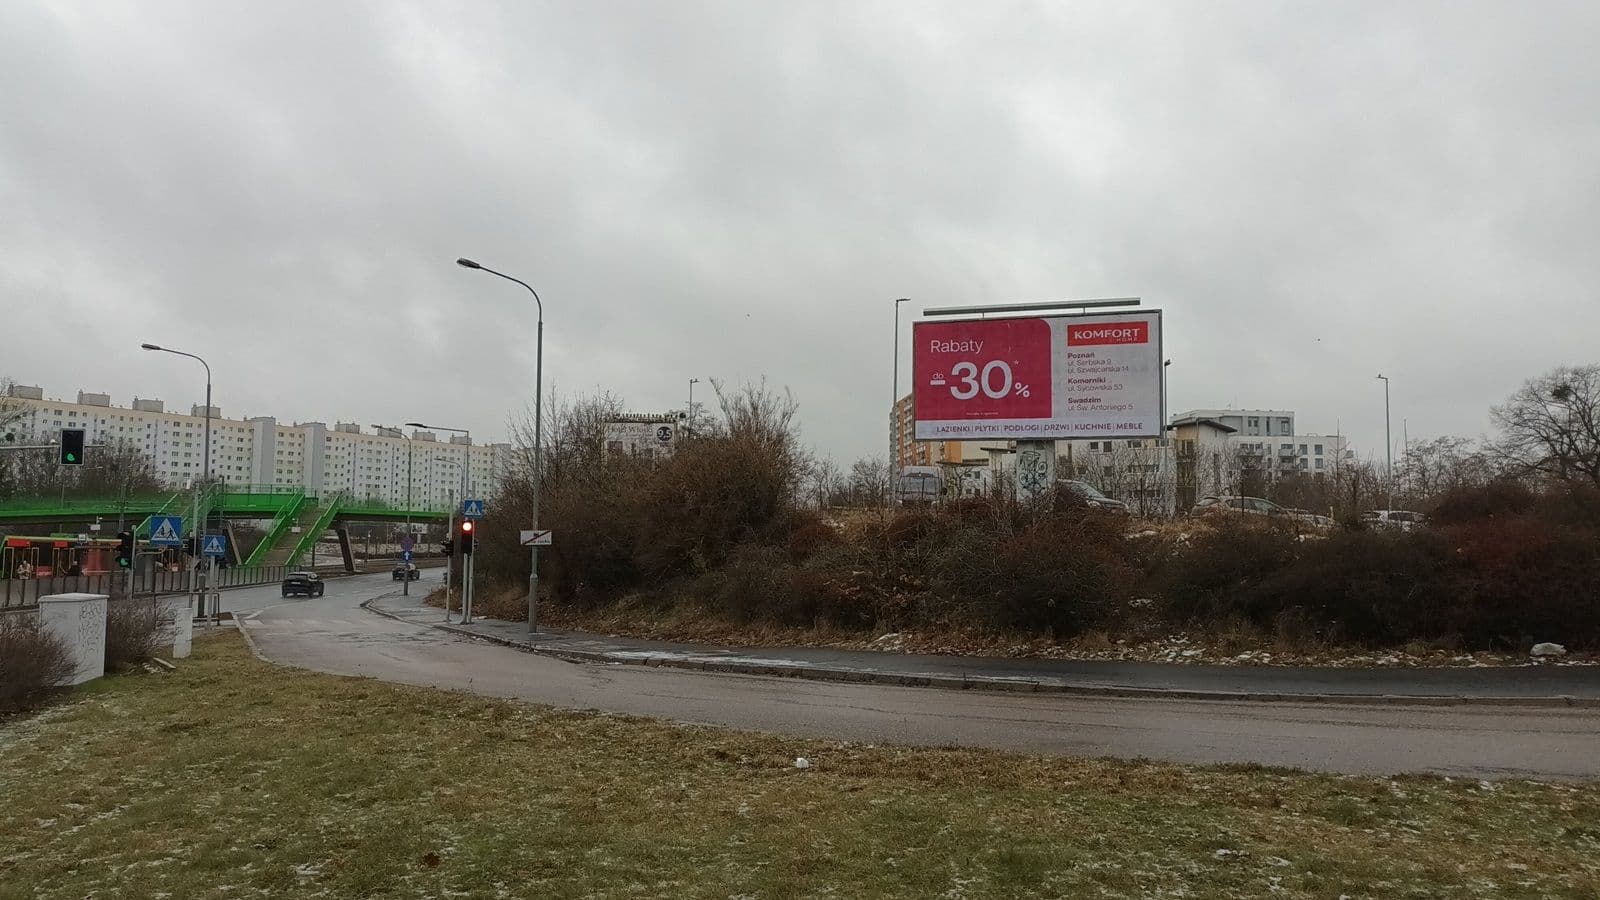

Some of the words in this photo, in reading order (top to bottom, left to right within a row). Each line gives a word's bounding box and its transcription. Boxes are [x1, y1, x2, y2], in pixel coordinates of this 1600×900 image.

[1074, 328, 1140, 339] KOMFORT
[930, 340, 984, 354] Rabaty
[932, 371, 944, 380] do
[1116, 422, 1143, 430] MEBLE
